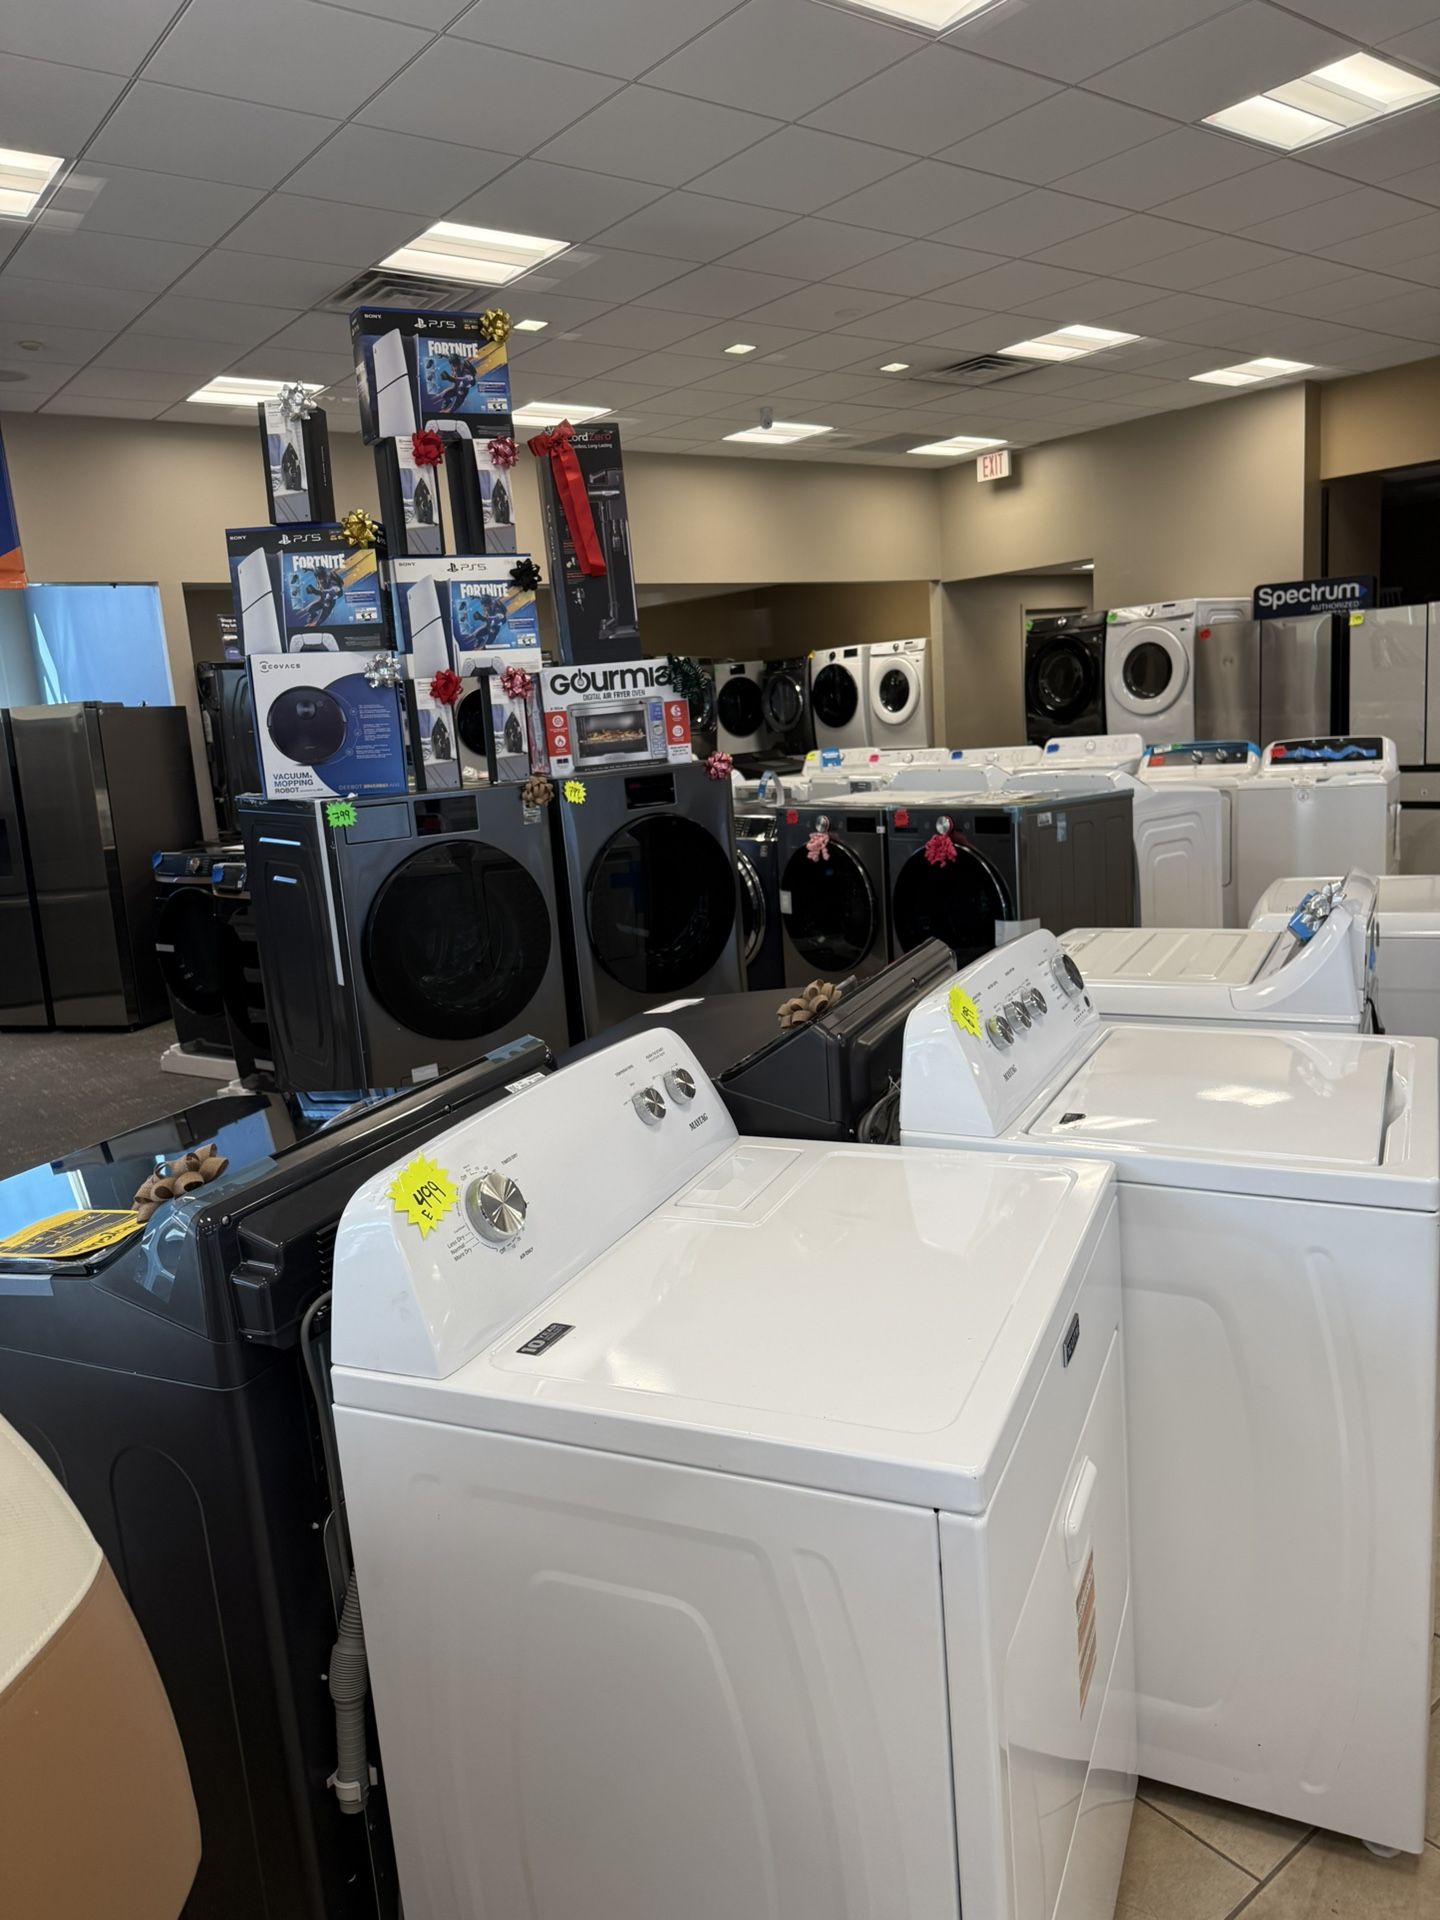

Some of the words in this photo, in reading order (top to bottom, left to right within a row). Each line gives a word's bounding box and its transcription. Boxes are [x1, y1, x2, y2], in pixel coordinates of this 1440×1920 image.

[428, 320, 456, 329] PS5
[427, 340, 479, 358] FORTNITE
[569, 432, 612, 441] ordZero
[983, 452, 1004, 478] EXIT
[293, 534, 322, 543] PS5
[292, 553, 346, 571] FORTNITE
[459, 583, 509, 599] FORTNITE
[1258, 582, 1360, 610] Spectrum
[1311, 600, 1360, 611] AUTHORIZED
[260, 662, 301, 672] ECOVACS
[583, 693, 602, 701] DIGITAL
[613, 690, 631, 698] FRYER
[274, 779, 314, 787] MOPPING
[331, 810, 351, 822] 799
[412, 1181, 447, 1209] 499
[450, 1243, 466, 1255] Normal
[520, 1340, 546, 1353] 10
